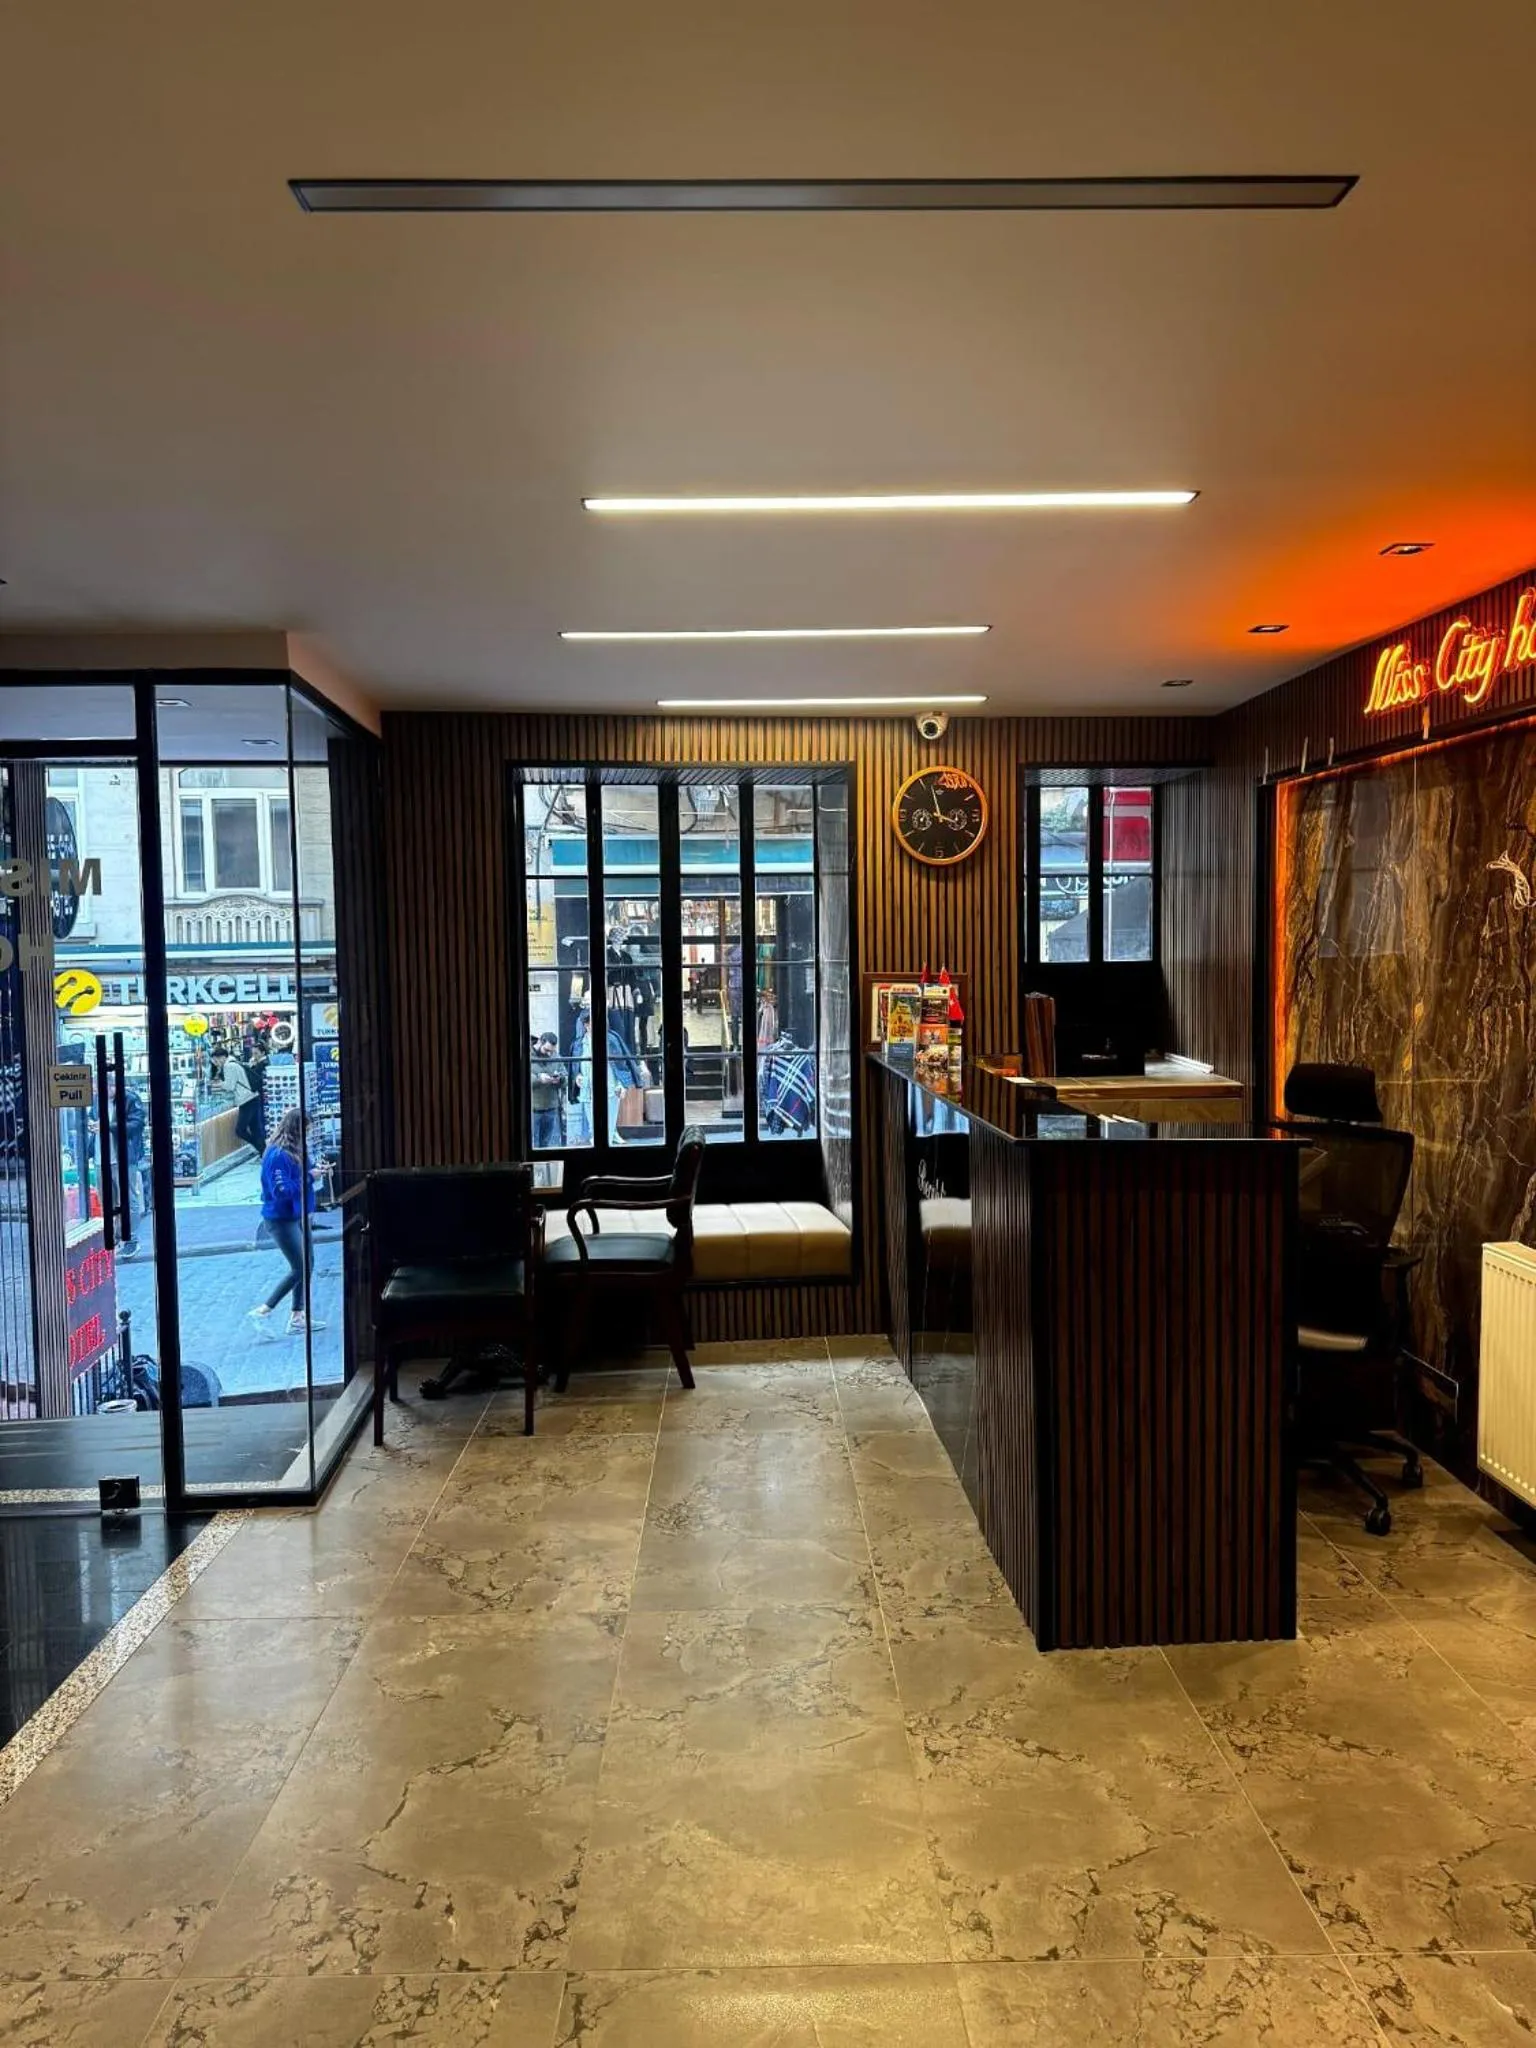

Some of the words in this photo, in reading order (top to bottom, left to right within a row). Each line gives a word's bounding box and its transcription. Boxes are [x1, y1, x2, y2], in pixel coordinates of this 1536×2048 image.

[1364, 643, 1427, 714] Miss
[1436, 619, 1504, 703] City
[60, 1090, 82, 1100] Pull
